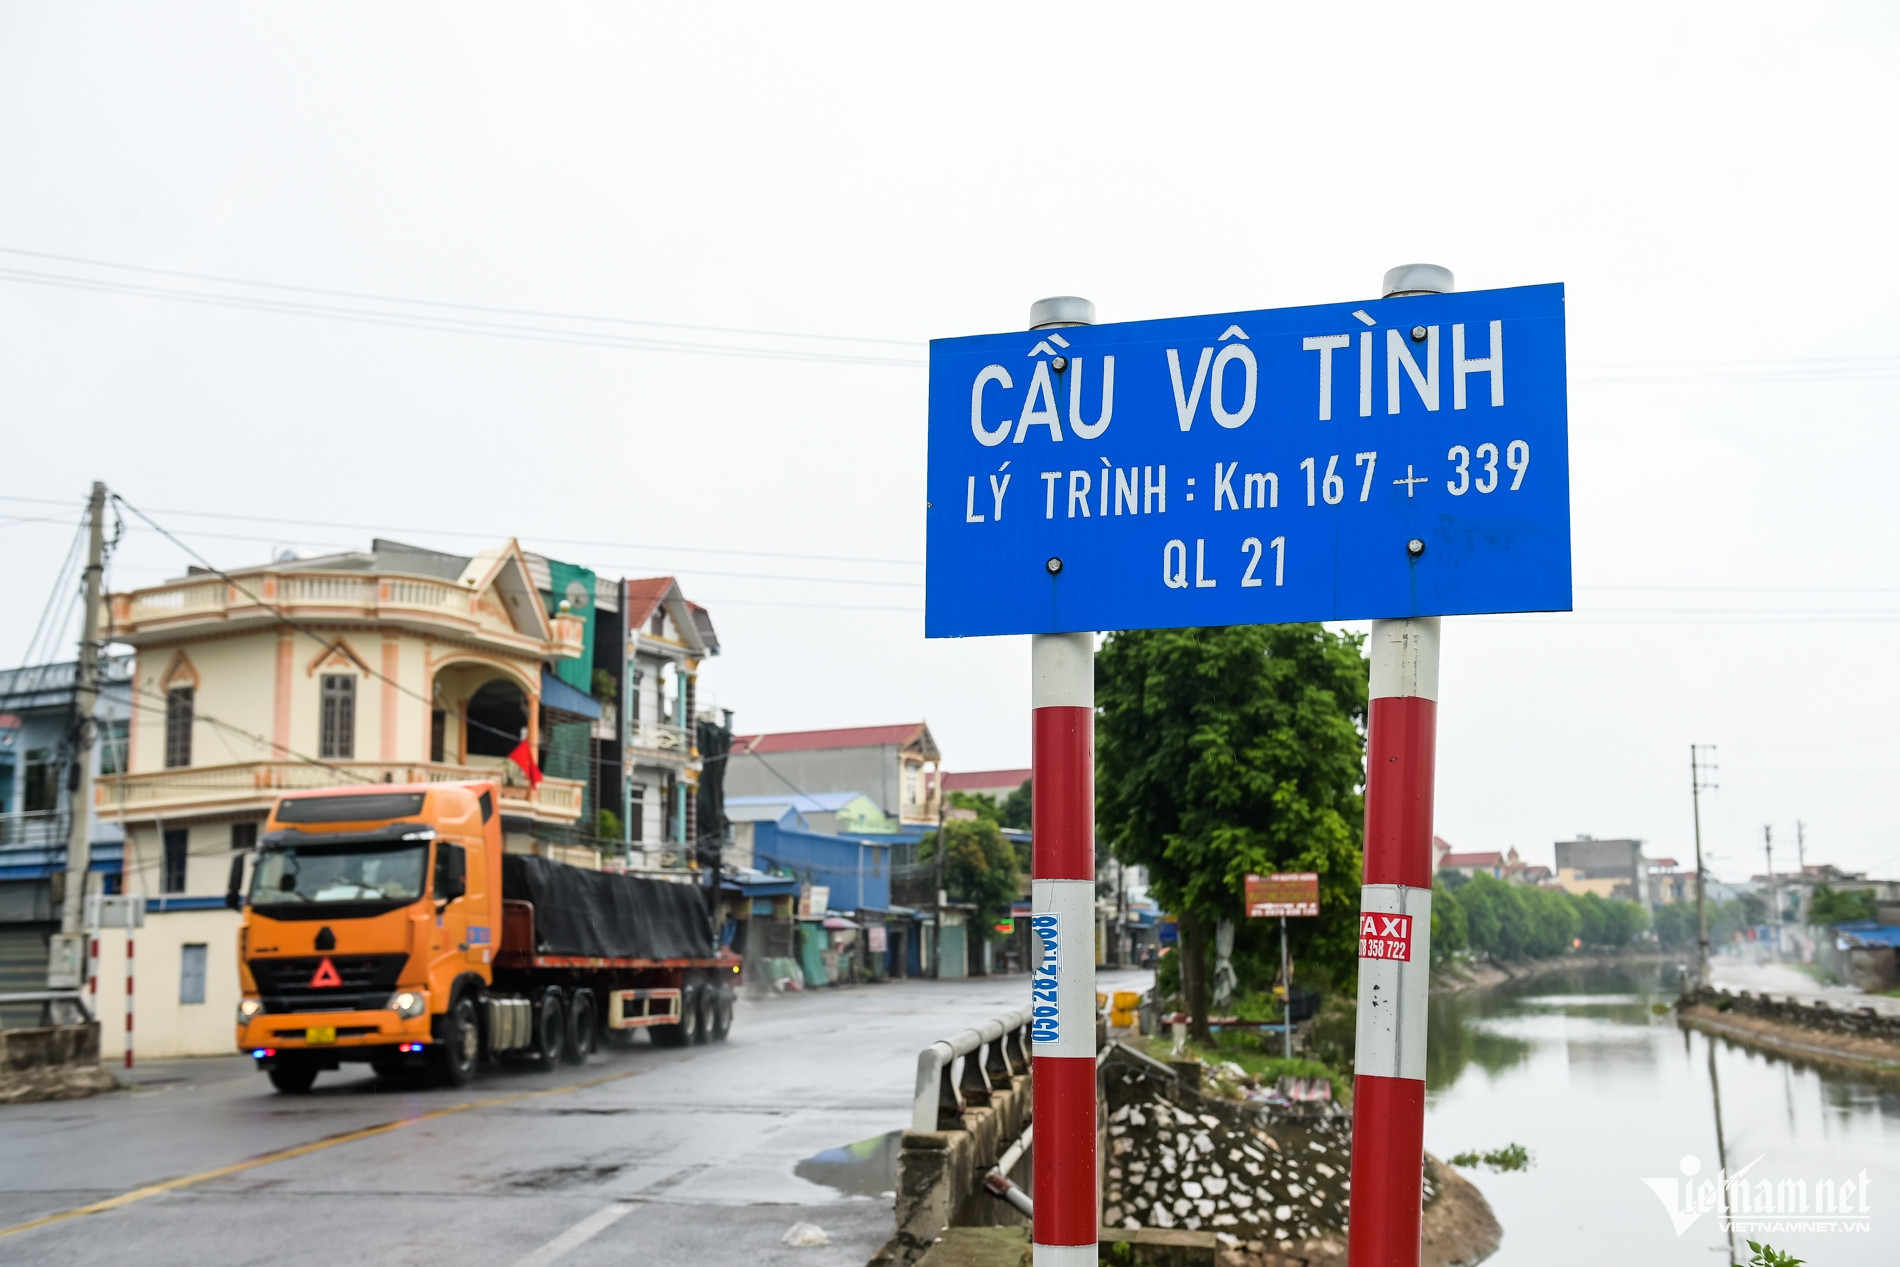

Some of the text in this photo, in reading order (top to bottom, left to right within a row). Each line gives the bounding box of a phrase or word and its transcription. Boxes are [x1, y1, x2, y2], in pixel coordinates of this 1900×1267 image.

[970, 310, 1505, 447] CẦU VÔ TÌNH
[966, 440, 1530, 523] LÝ TRÌNH : Km 167 + 339
[1163, 537, 1285, 589] QL 21
[1368, 939, 1384, 957] 358
[1387, 940, 1406, 959] 722
